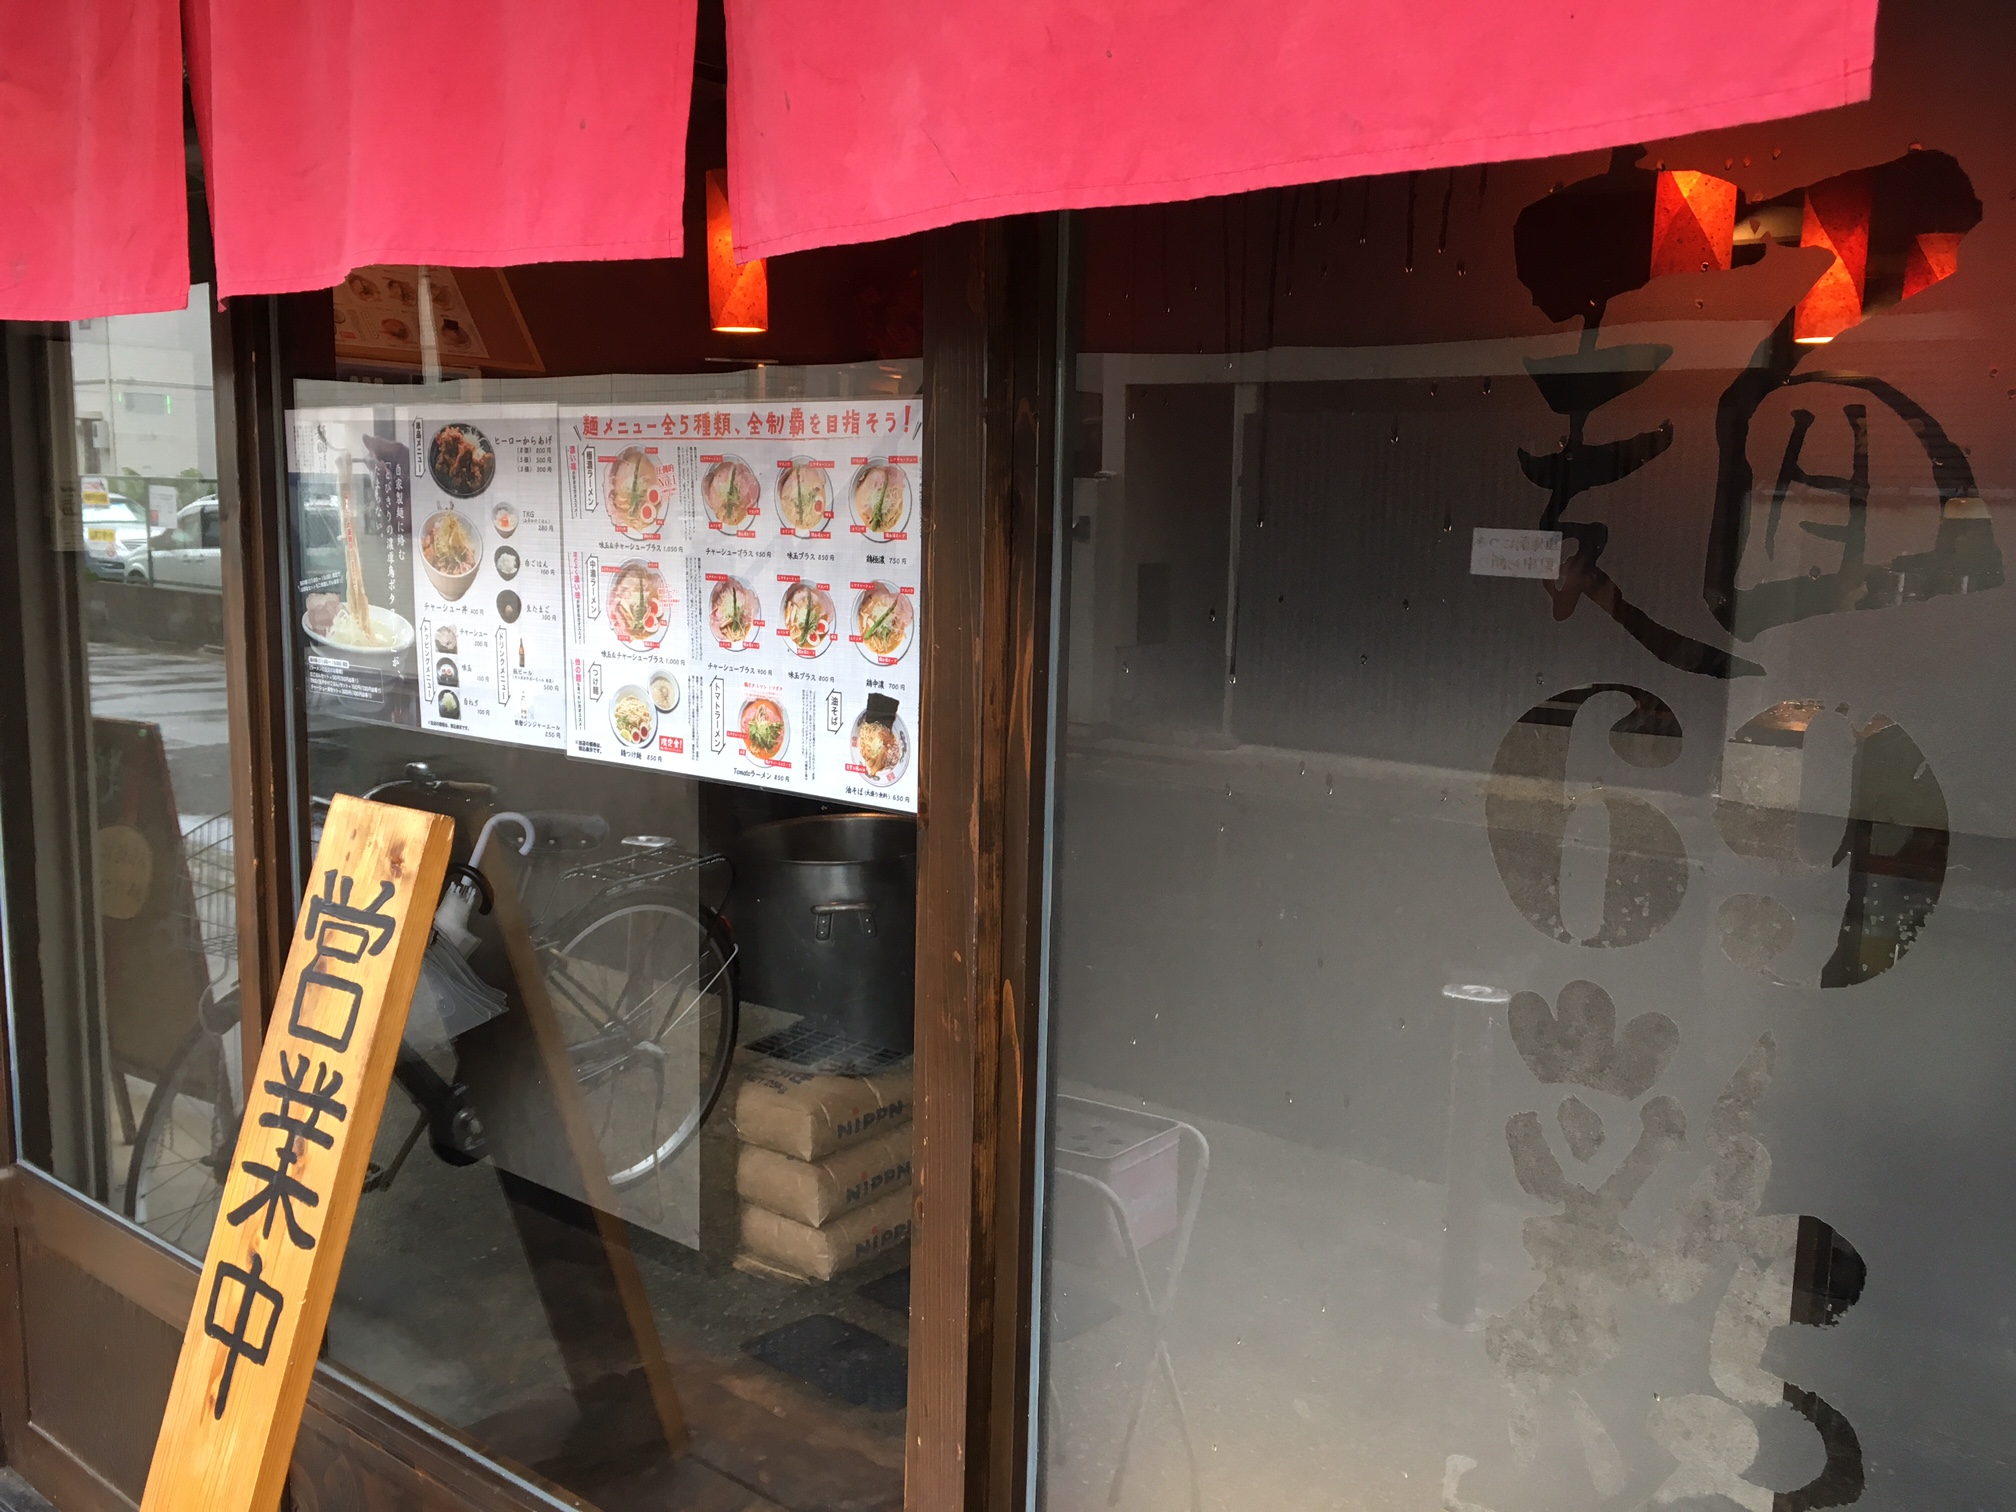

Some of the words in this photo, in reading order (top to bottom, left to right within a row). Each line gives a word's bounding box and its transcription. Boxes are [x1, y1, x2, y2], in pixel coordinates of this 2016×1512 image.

[583, 405, 911, 437] 麺メニュー全5種類、全制覇を目指そう!
[494, 436, 552, 446] ヒーローからあげ
[395, 463, 405, 560] 自家製麺に絡む
[705, 548, 754, 558] チャーシュープラス
[787, 552, 816, 561] 味玉プラス
[525, 558, 548, 568] 白ごはん
[889, 557, 907, 565] 750円
[590, 560, 598, 613] 中濃ラーメン
[542, 614, 557, 622] 100円
[460, 628, 488, 637] チャーシュー
[665, 657, 685, 667] 1,000円
[708, 662, 755, 675] チャーシュープラス
[788, 670, 816, 682] 味玉プラス
[543, 684, 560, 692] 500円
[888, 683, 906, 691] 700円
[477, 708, 490, 716] 100円
[545, 731, 561, 739] 250円
[845, 786, 863, 797] 油そば
[893, 795, 910, 804] 650円
[204, 868, 397, 1420] 営業中
